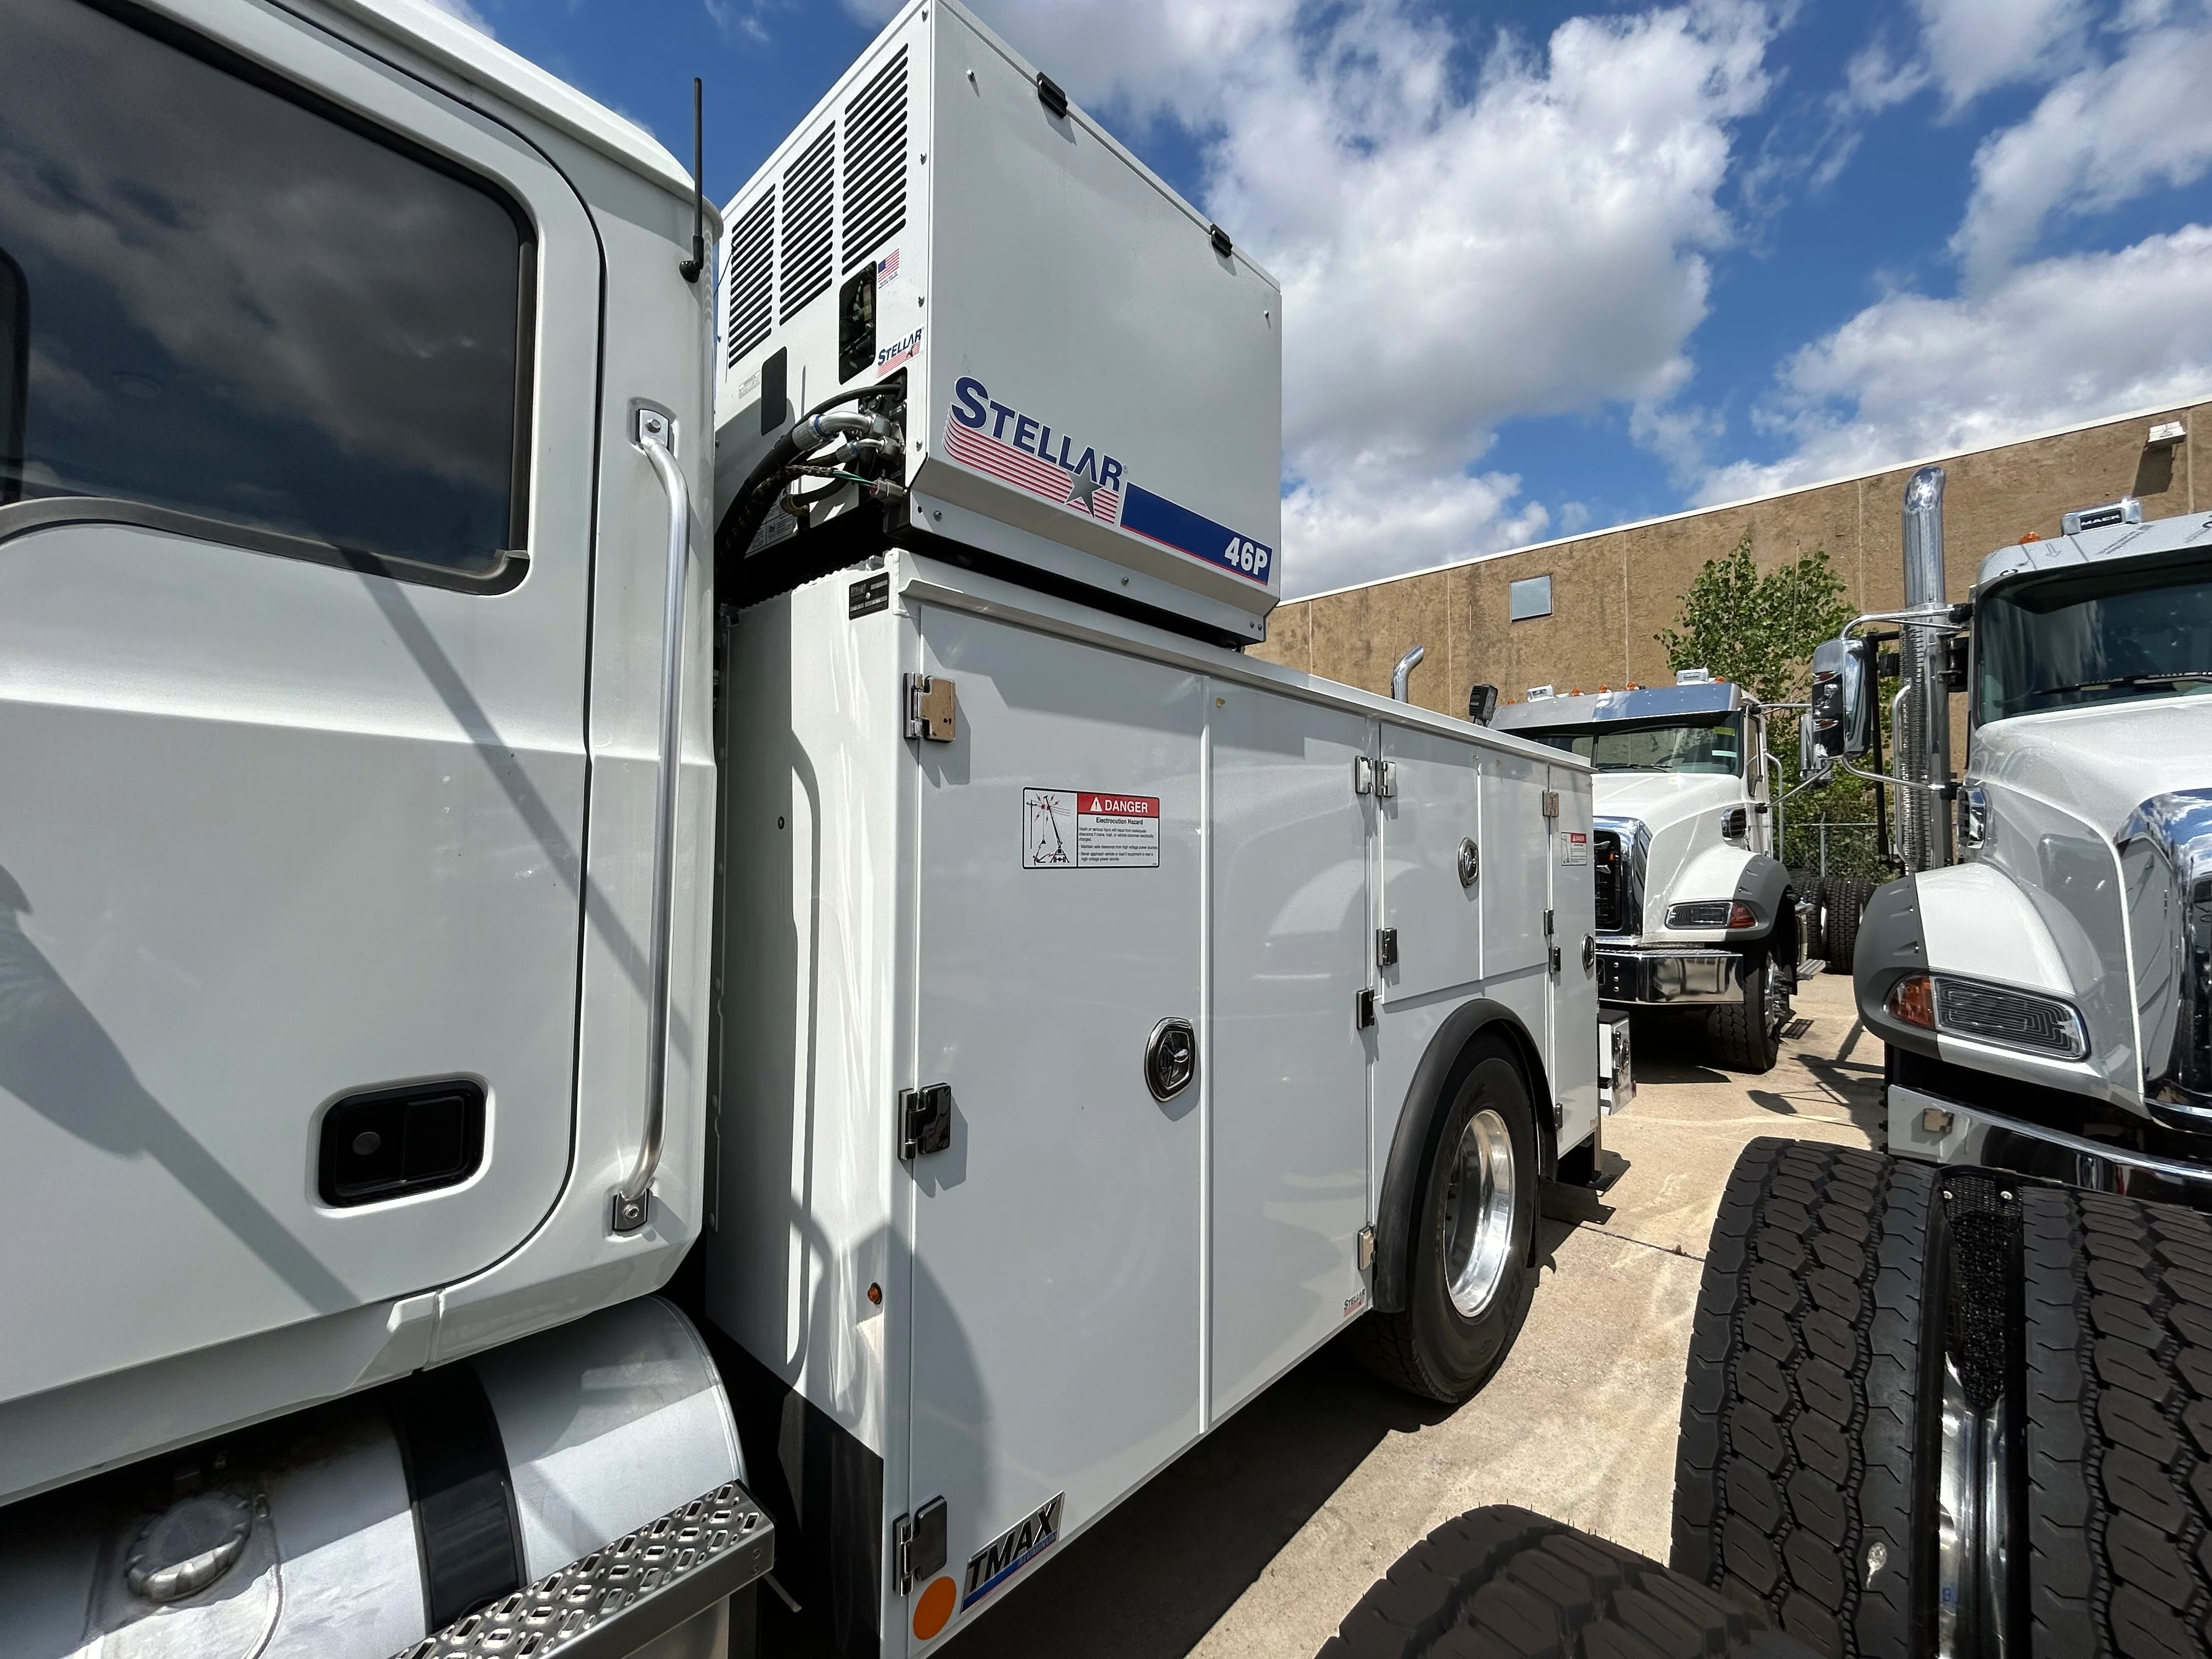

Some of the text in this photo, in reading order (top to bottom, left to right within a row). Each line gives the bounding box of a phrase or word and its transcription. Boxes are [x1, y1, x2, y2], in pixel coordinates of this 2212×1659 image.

[878, 328, 922, 366] STELLAR
[951, 376, 1123, 491] STELLAR
[2081, 514, 2121, 526] MACK
[1224, 537, 1268, 576] 46P
[1105, 799, 1148, 813] DANGER
[1344, 1288, 1365, 1310] STELLAR
[968, 1499, 1058, 1593] TMAX
